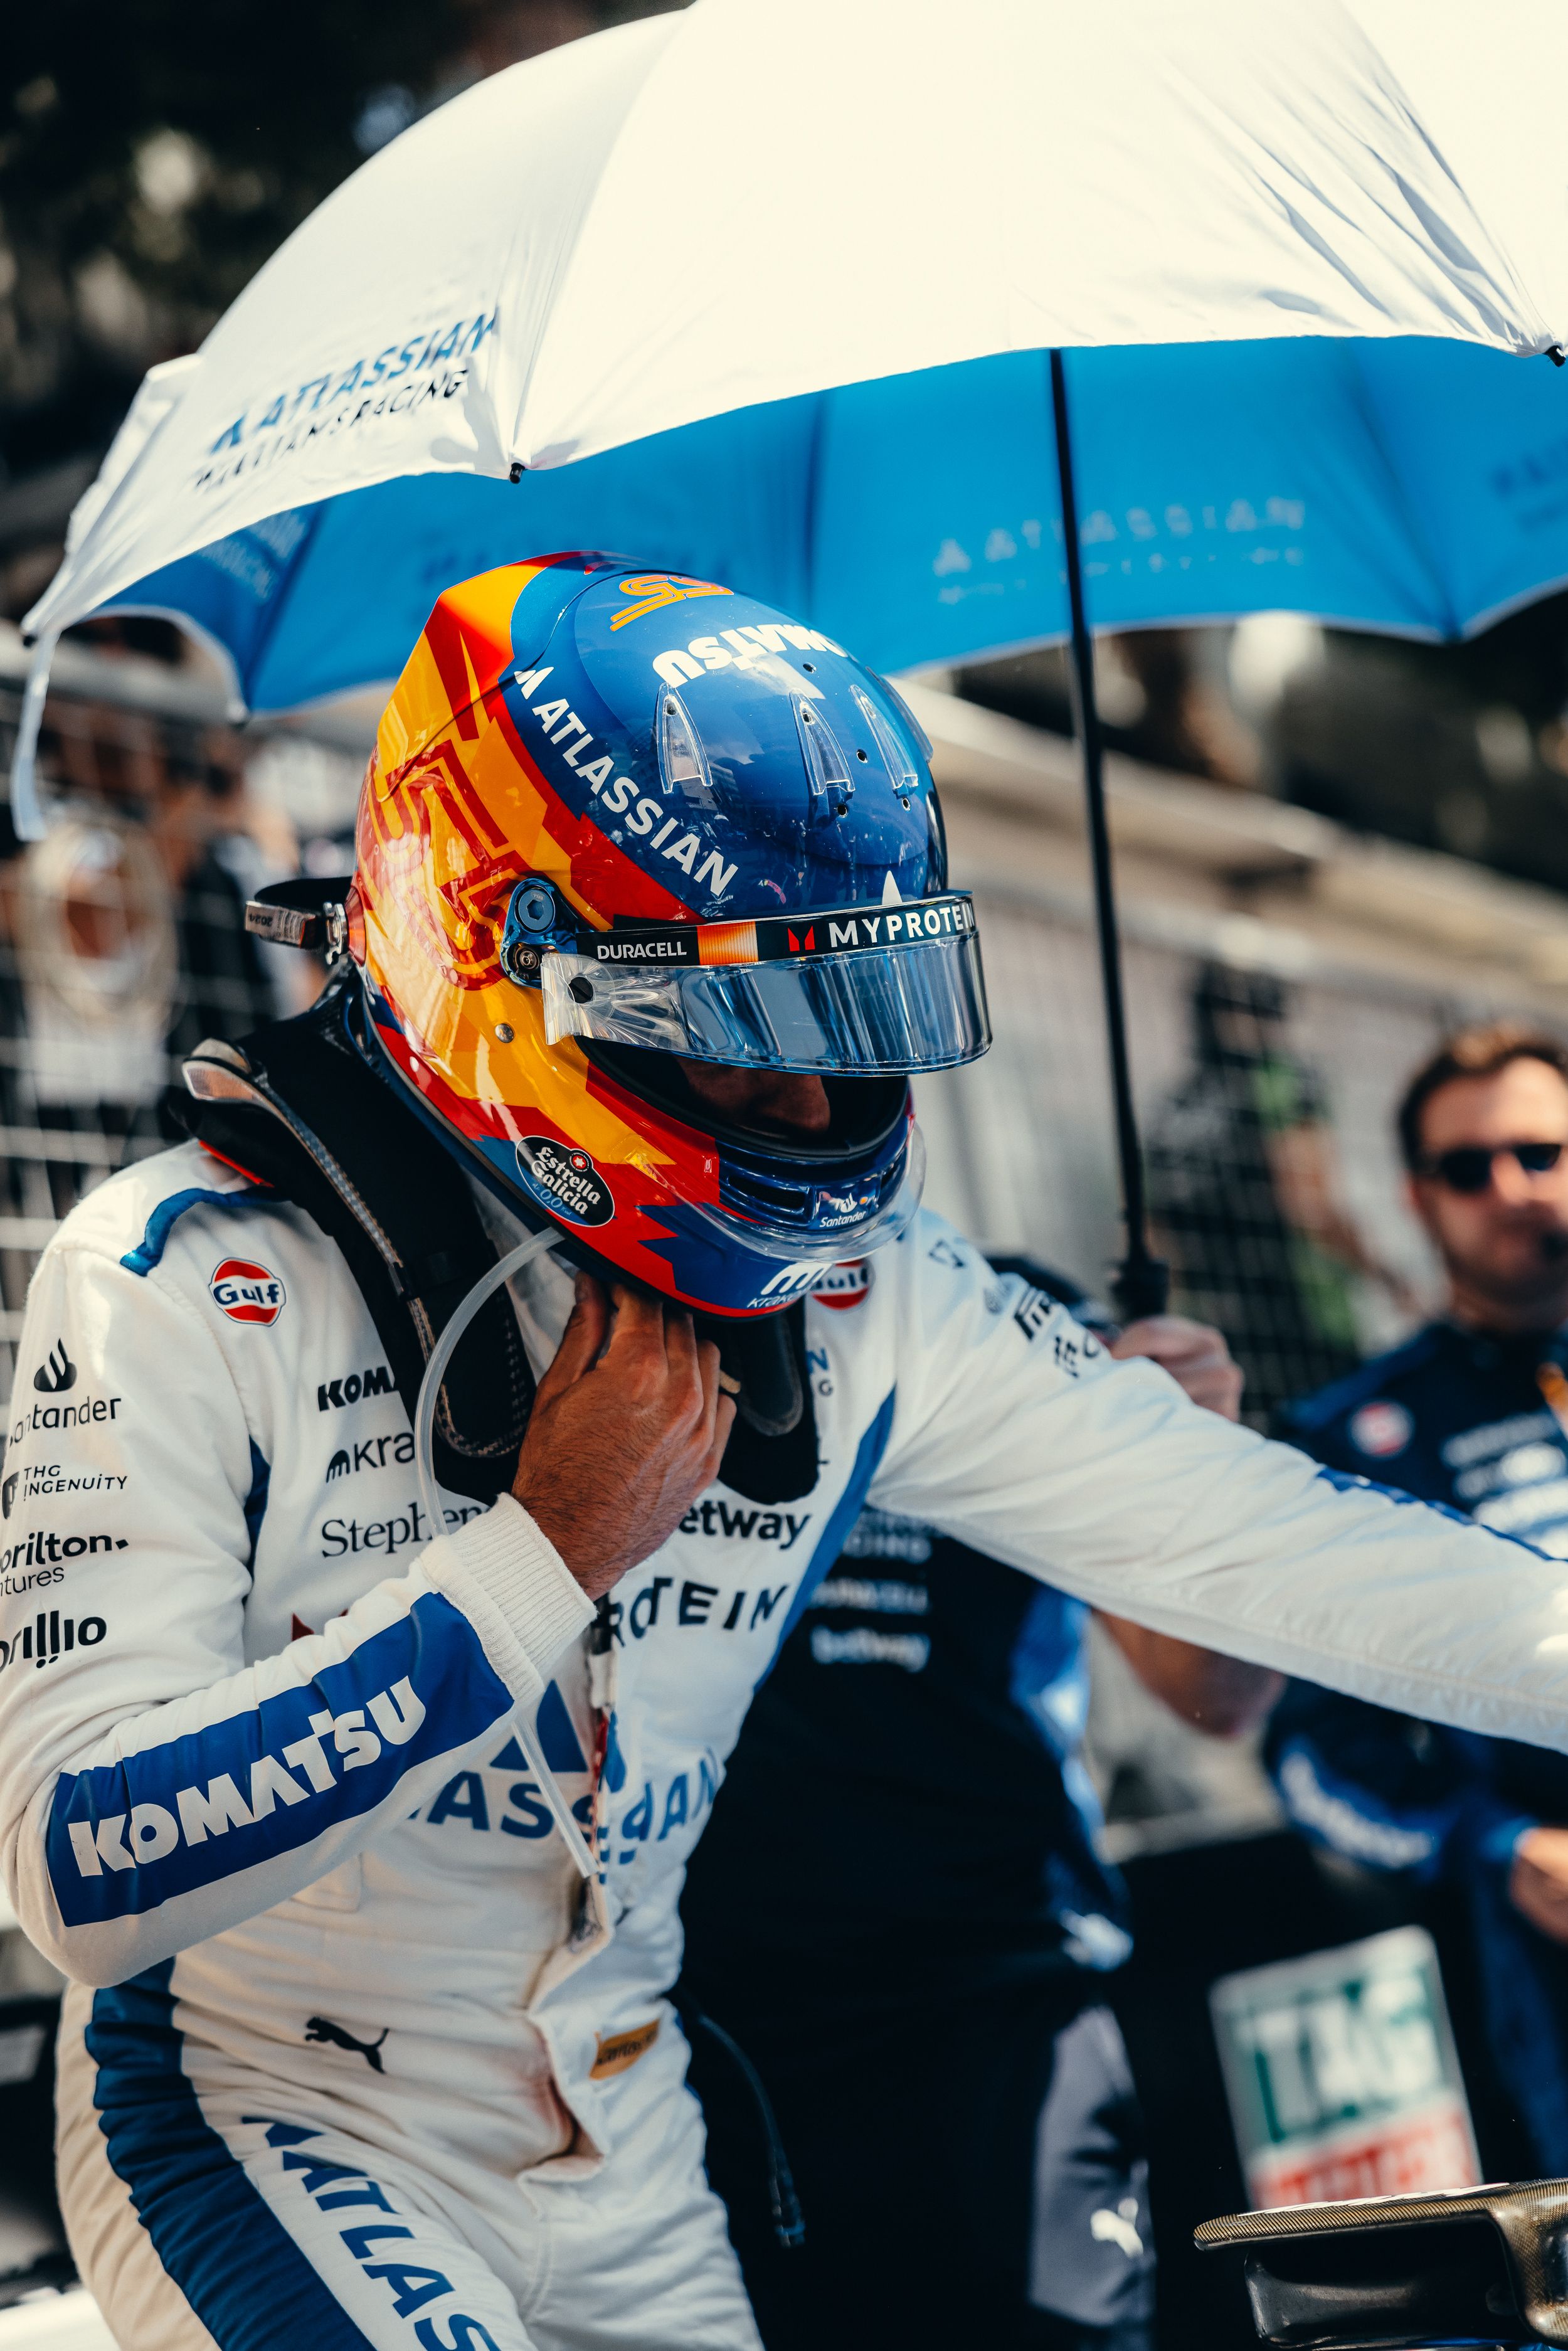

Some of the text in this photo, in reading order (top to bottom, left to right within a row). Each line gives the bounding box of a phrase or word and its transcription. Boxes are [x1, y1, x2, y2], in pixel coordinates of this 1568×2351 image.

[532, 698, 739, 896] ATLASSIAN
[829, 903, 975, 948] MYPROTEIN
[597, 941, 687, 960] DURACELL
[531, 1160, 588, 1214] Galicia
[536, 1147, 601, 1205] Estrella
[819, 1211, 867, 1228] Santander
[213, 1283, 280, 1307] Gulf
[9, 1396, 122, 1448] antander
[24, 1465, 61, 1480] THG
[354, 1431, 416, 1472] kra
[679, 1500, 812, 1550] etway
[67, 1675, 426, 1877] KOMATSU
